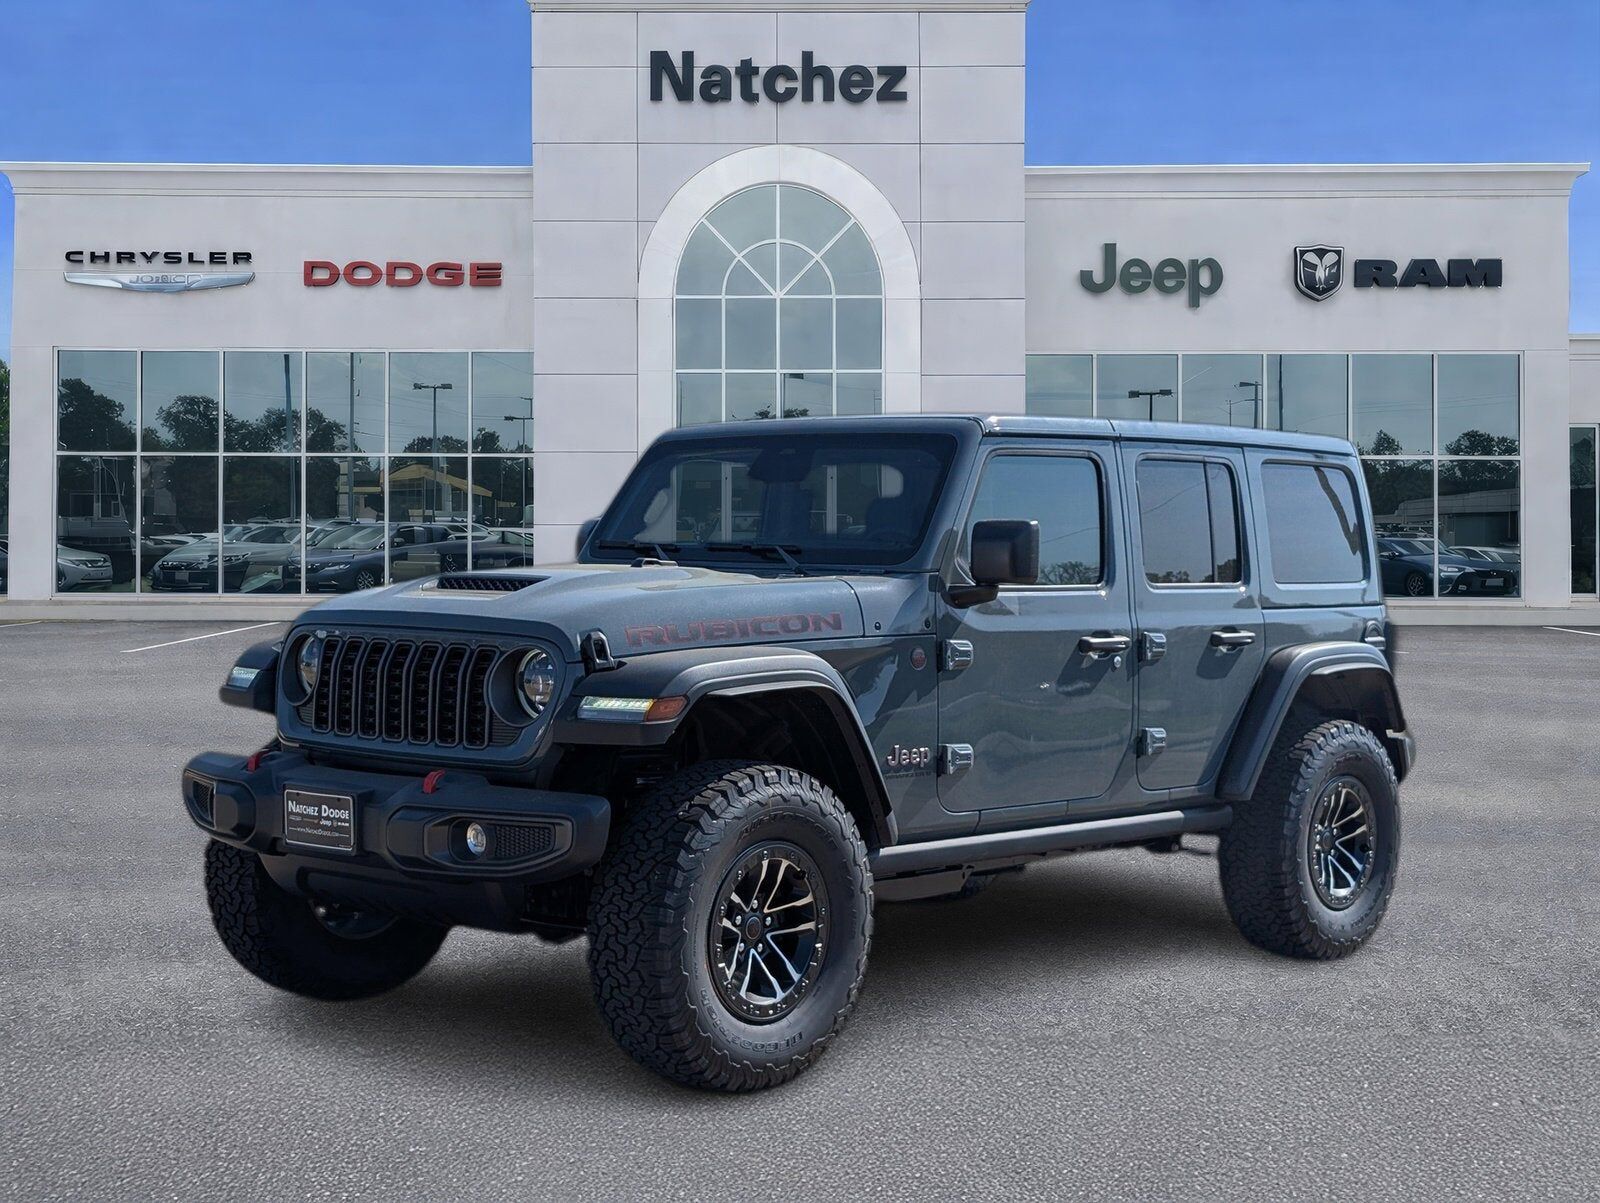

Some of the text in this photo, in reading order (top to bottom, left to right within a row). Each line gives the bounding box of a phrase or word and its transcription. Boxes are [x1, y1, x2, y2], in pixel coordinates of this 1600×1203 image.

[649, 50, 908, 104] Natchez
[64, 250, 253, 265] CHRYSLER
[303, 260, 503, 287] DODGE
[1079, 242, 1224, 310] Jeep
[1353, 258, 1503, 288] RAM
[624, 611, 843, 648] RUBICON
[886, 744, 931, 768] Jeep
